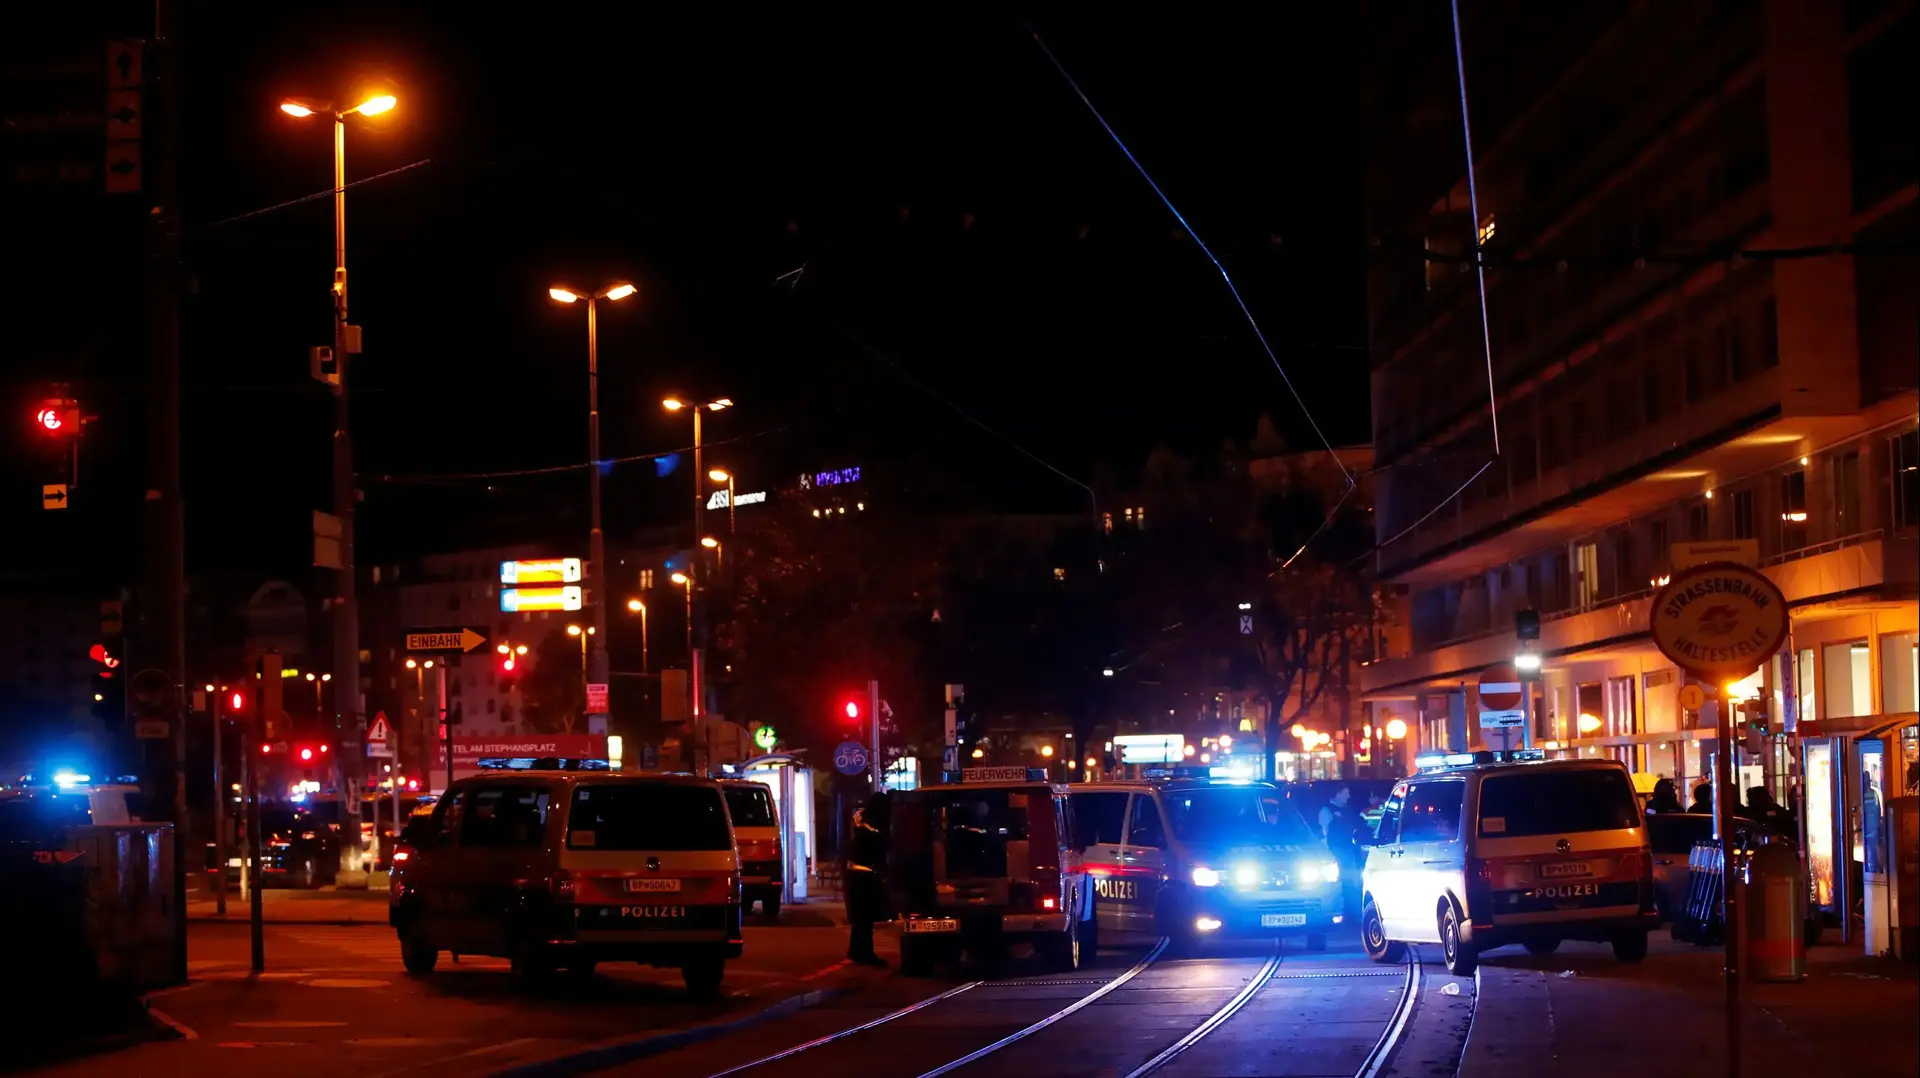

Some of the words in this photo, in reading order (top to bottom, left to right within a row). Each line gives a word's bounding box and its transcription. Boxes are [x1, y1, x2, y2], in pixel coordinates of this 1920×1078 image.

[1665, 577, 1771, 619] STRASSENBAHN
[410, 634, 461, 648] EINBAHN
[1673, 627, 1769, 663] HALTESTELLE
[439, 744, 469, 754] HTEL
[470, 744, 483, 753] AM
[484, 743, 556, 753] STEPHANSPLATZ
[963, 768, 1025, 781] FEUERWEHR
[1535, 884, 1599, 898] POLIZEI
[621, 906, 686, 918] POLIZEI
